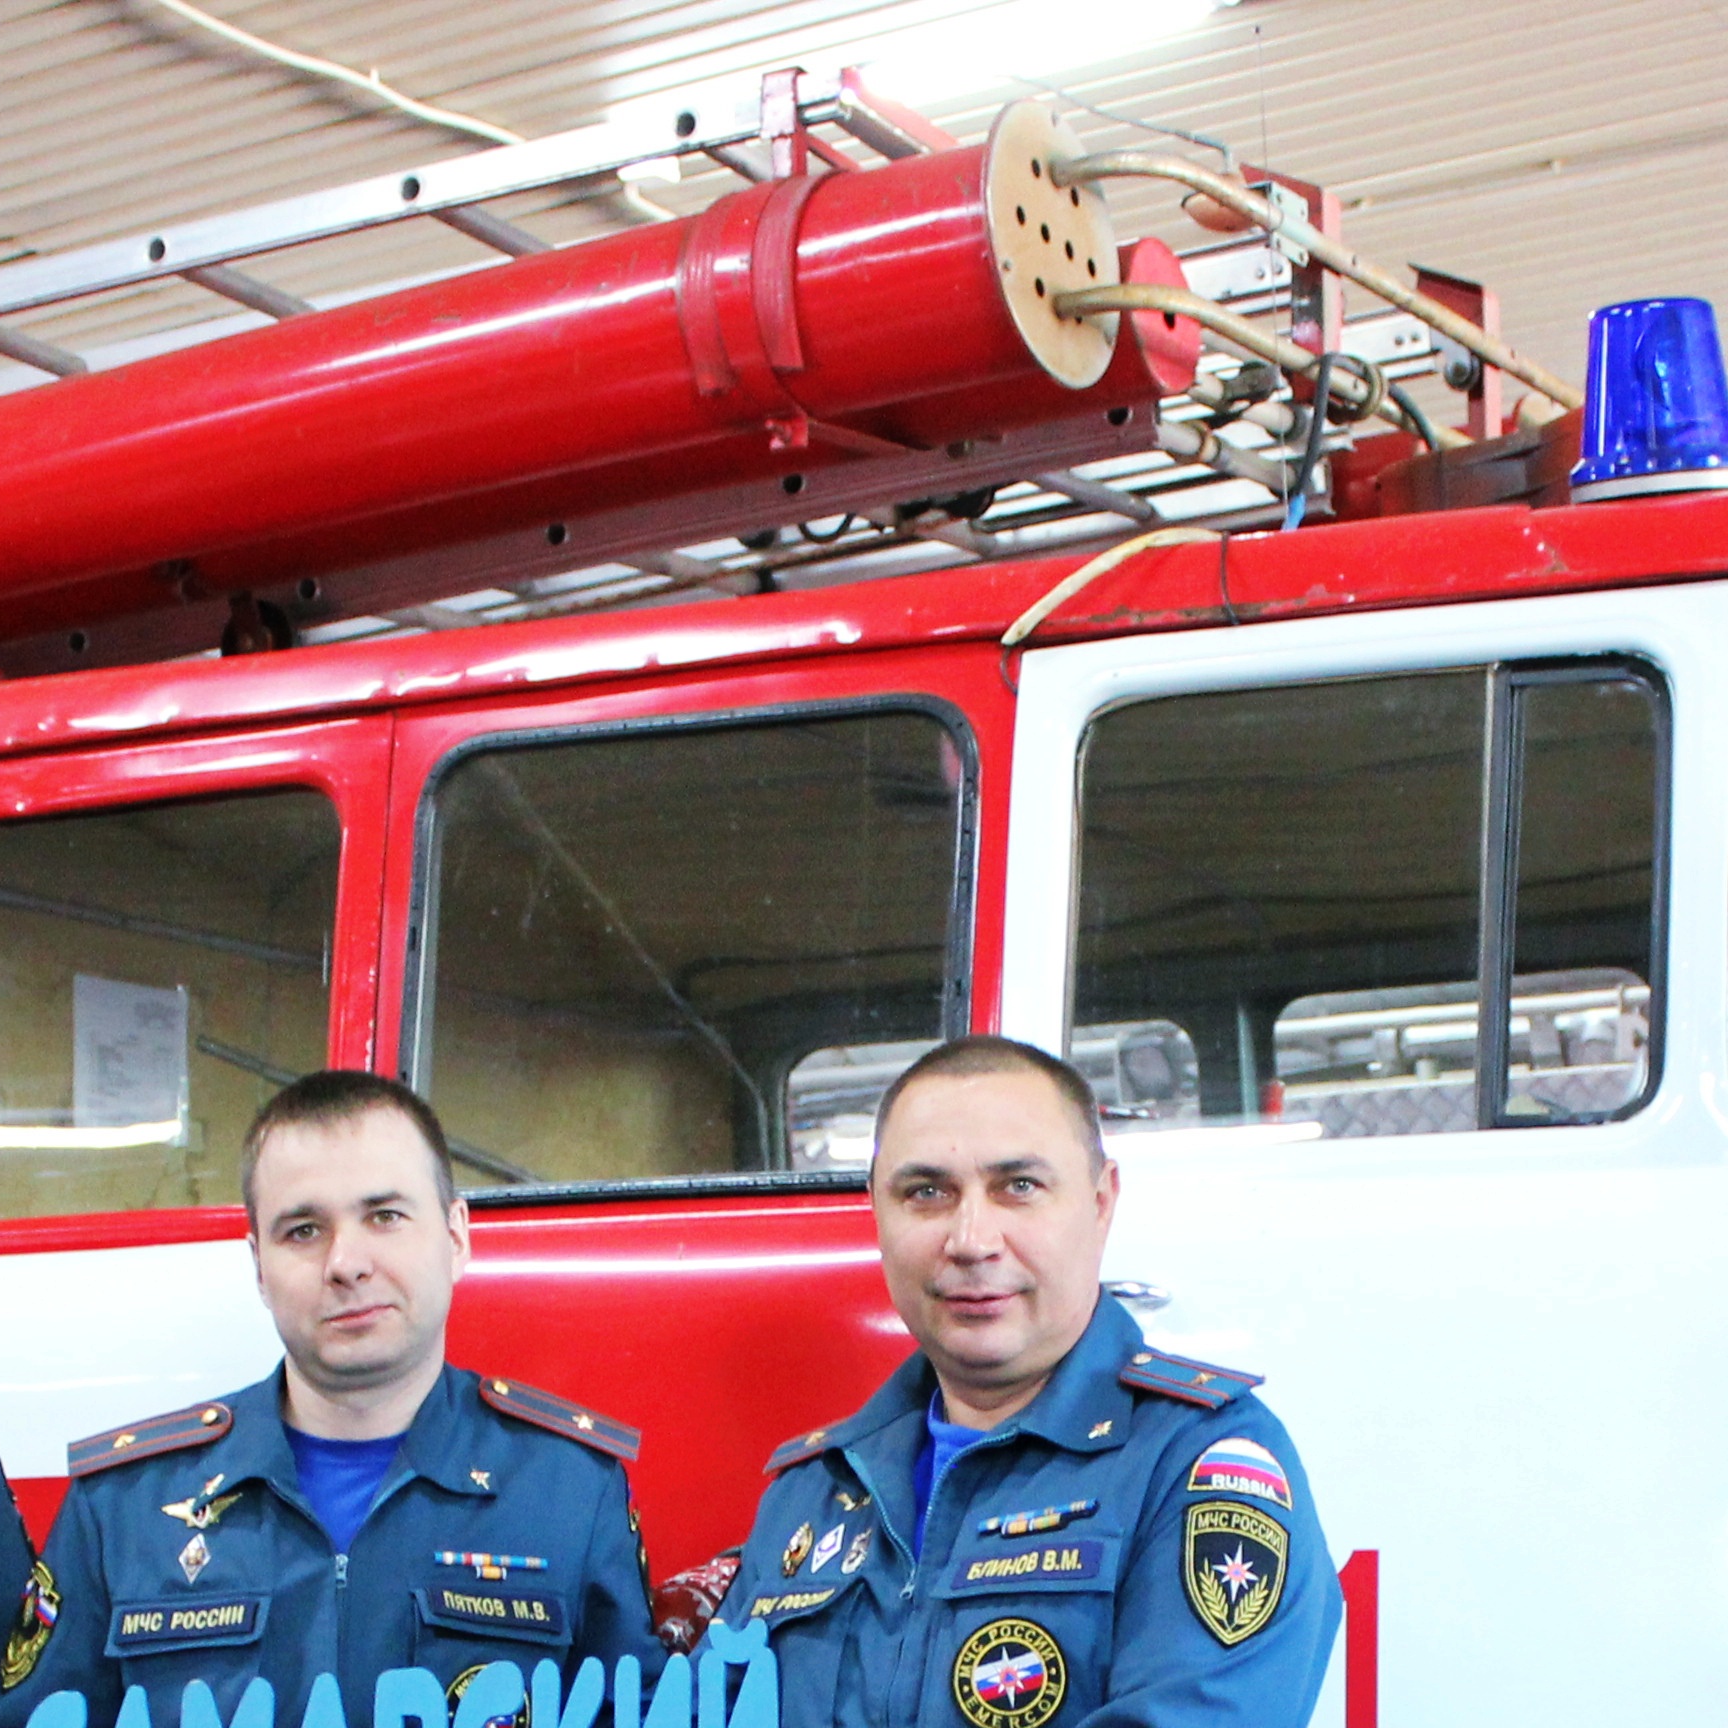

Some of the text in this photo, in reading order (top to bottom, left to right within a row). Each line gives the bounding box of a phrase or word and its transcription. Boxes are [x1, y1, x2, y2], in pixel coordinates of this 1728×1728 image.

[1211, 1472, 1278, 1501] RUSSIA
[1197, 1511, 1282, 1549] МЧС РОССИИ
[966, 1548, 1083, 1580] БЛИНОВ В.М.
[121, 1604, 246, 1635] МЧС РОССИИ
[442, 1589, 551, 1622] ПЯТКОВ М.В.
[959, 1624, 1056, 1678] МЧС РОССИИ
